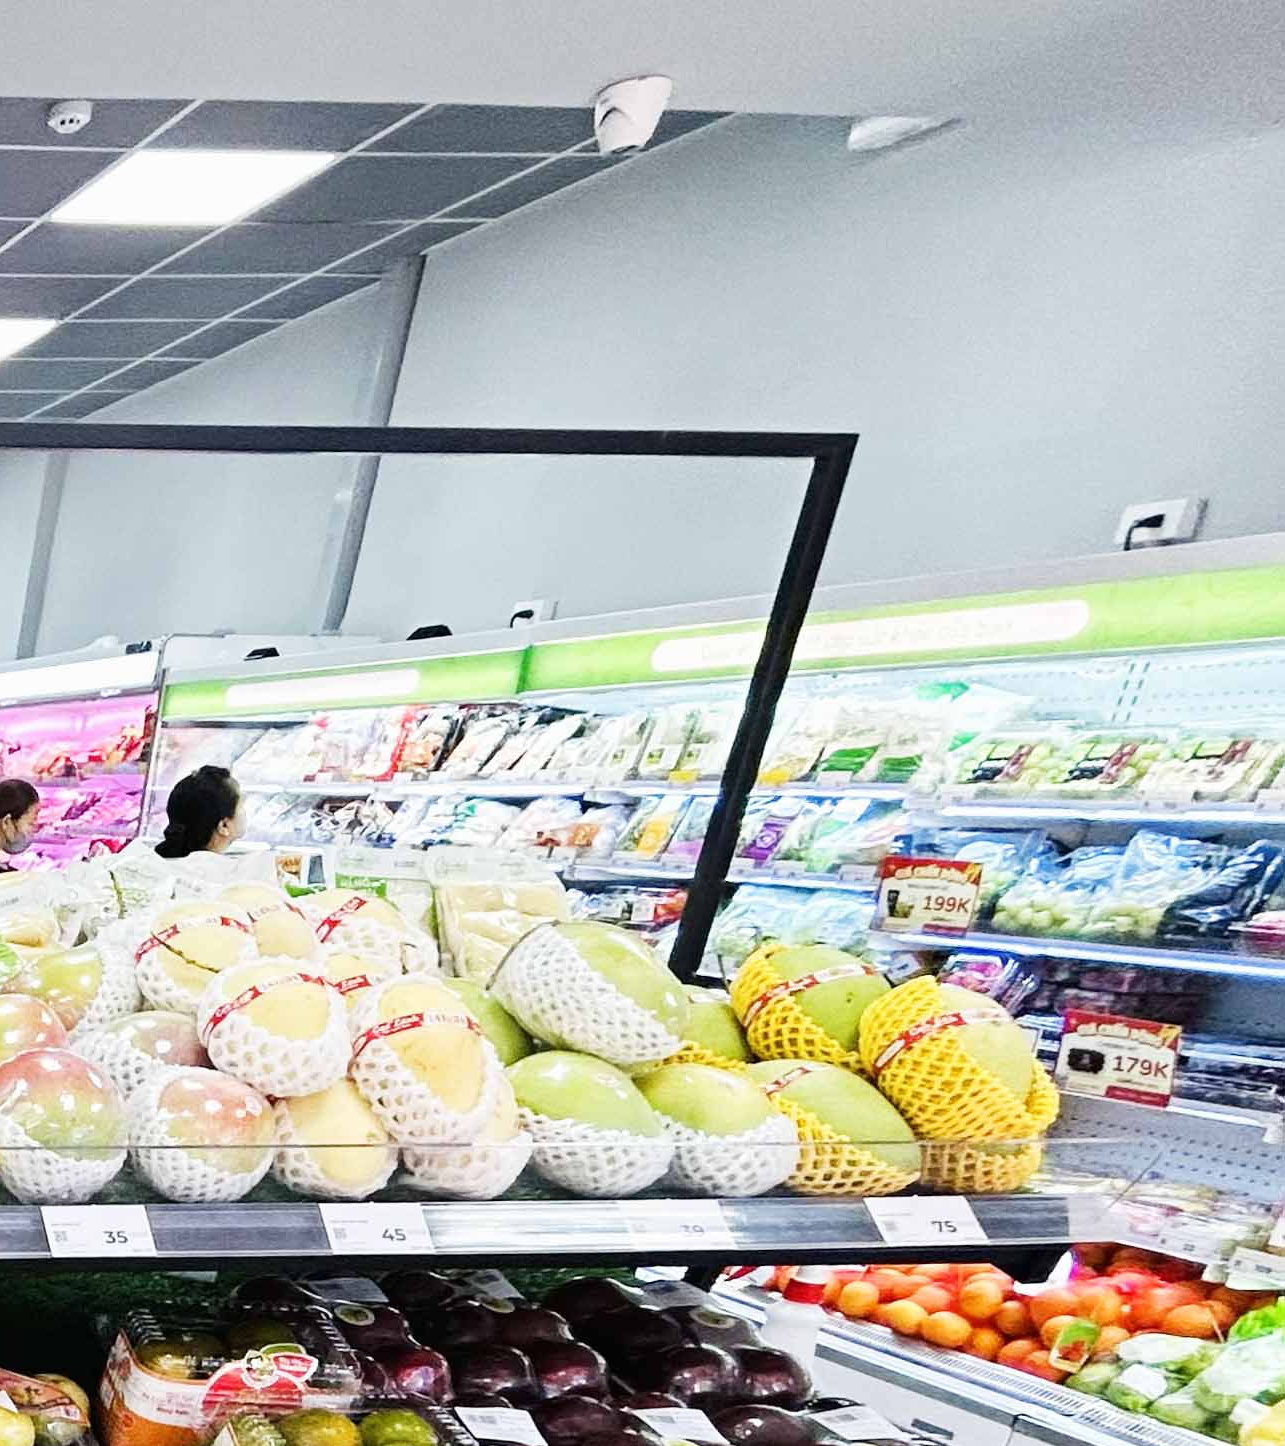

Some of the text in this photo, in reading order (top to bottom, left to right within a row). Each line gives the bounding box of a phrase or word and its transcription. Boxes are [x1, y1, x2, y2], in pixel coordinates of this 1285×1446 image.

[923, 894, 971, 914] 199K
[1112, 1055, 1170, 1079] 179K
[930, 1220, 958, 1233] 75
[103, 1230, 129, 1244] 35
[382, 1228, 407, 1242] 45
